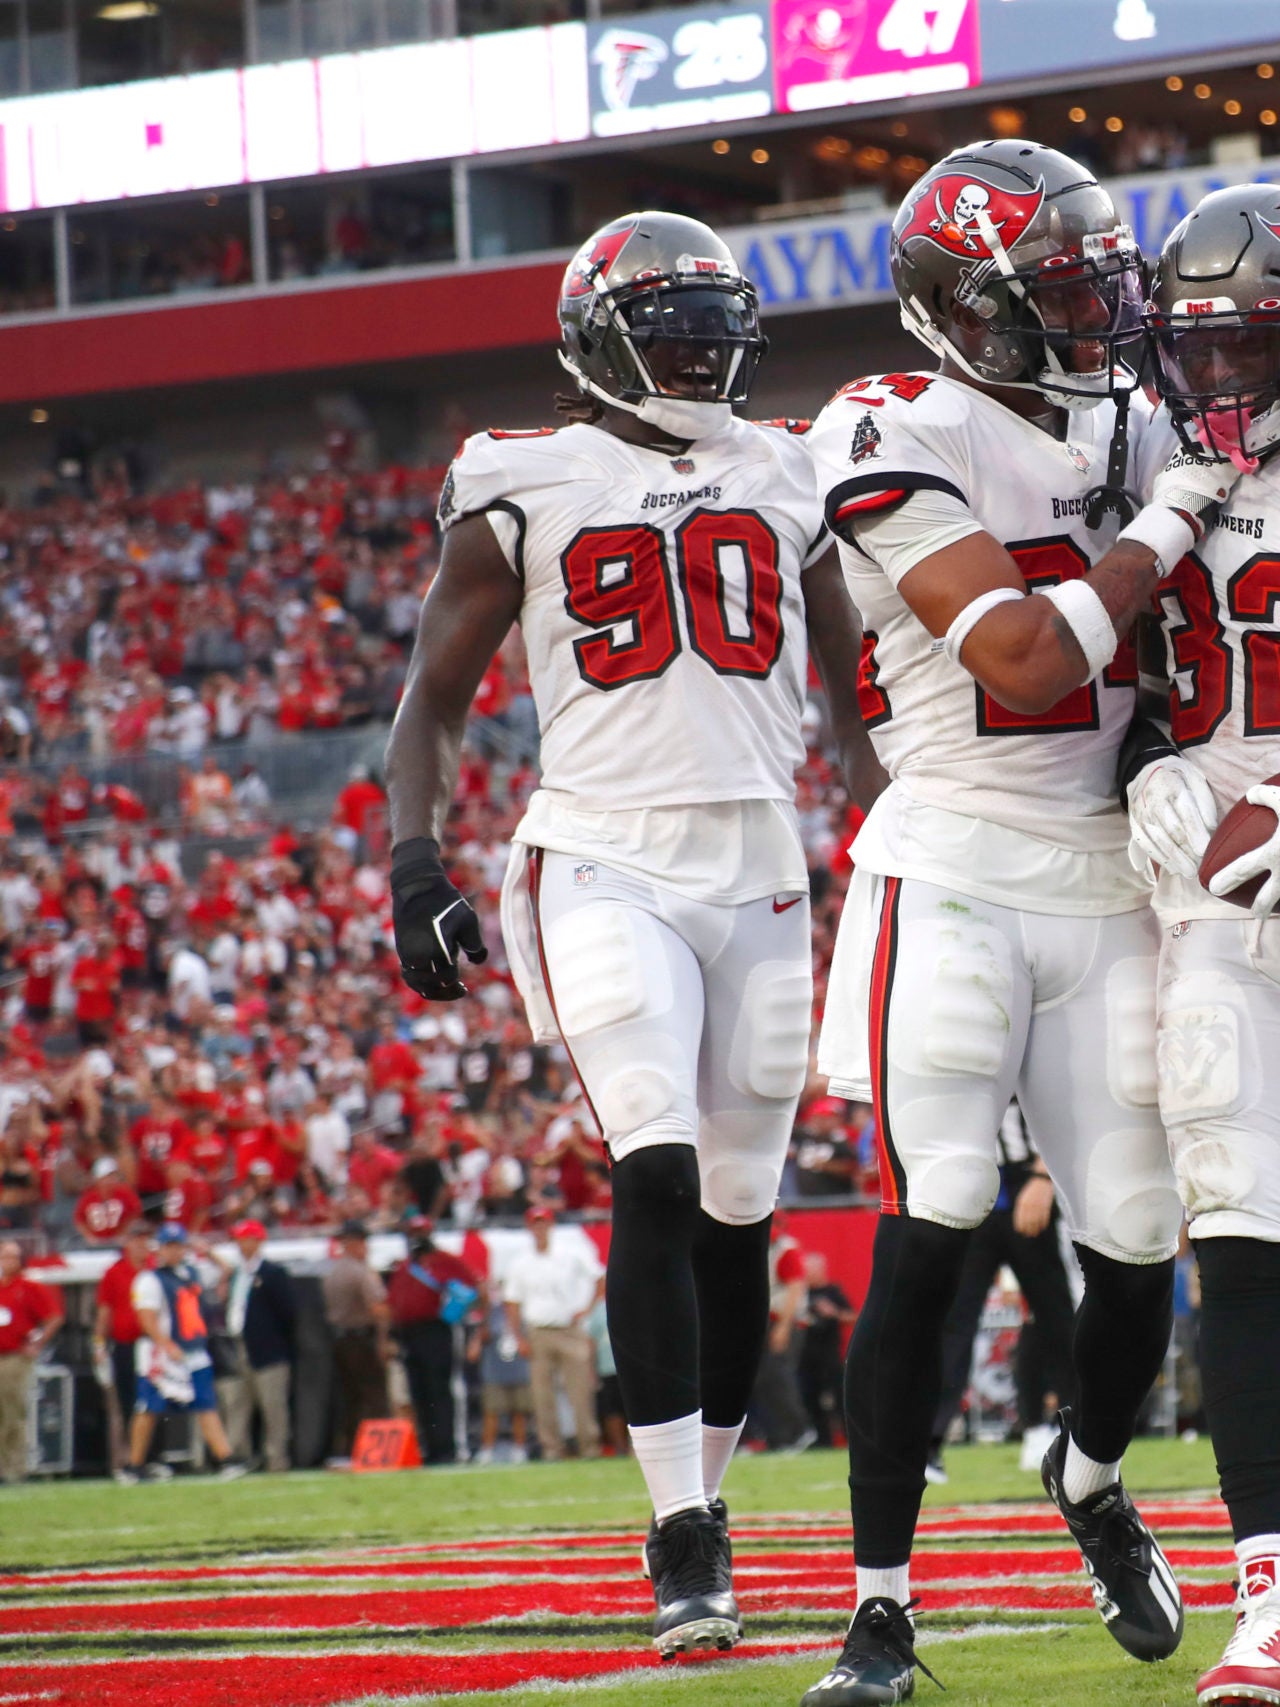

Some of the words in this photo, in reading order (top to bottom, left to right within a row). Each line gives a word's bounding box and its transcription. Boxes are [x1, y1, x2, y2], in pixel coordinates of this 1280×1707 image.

[673, 13, 767, 90] 25
[877, 0, 968, 58] 47
[560, 507, 785, 692] 90
[362, 1428, 402, 1468] 20
